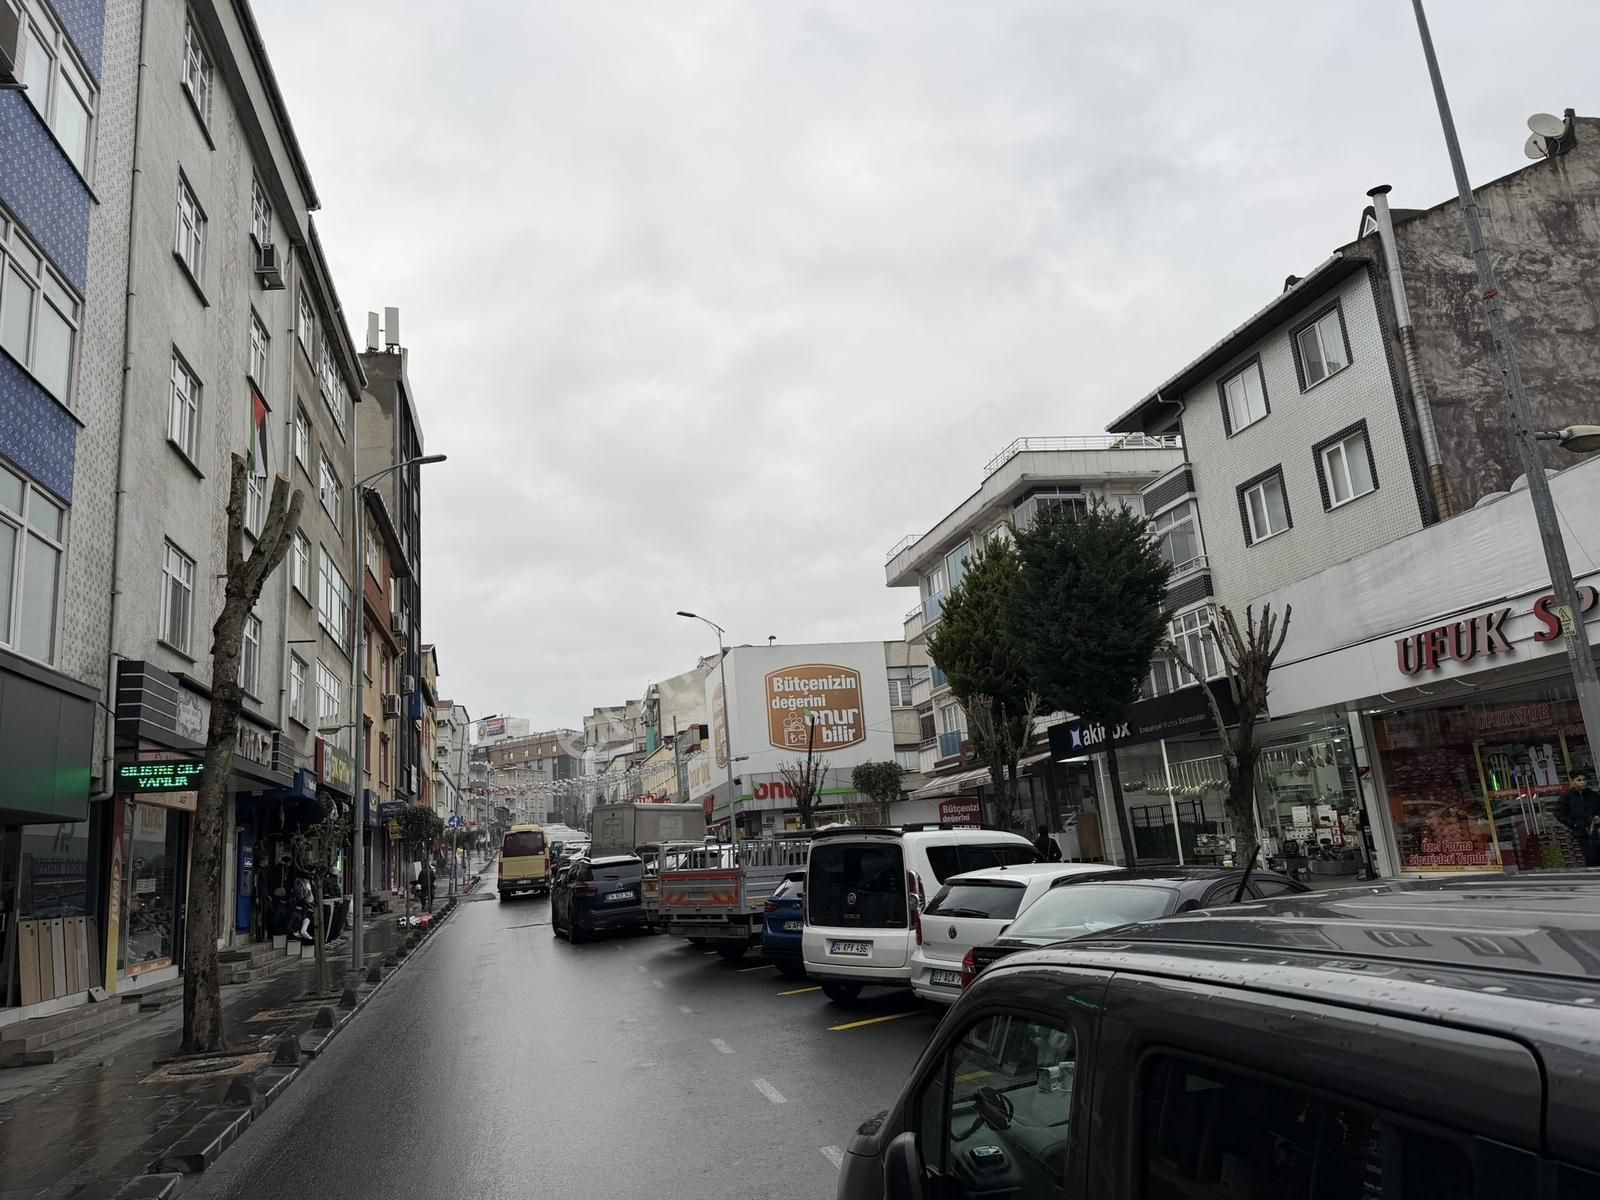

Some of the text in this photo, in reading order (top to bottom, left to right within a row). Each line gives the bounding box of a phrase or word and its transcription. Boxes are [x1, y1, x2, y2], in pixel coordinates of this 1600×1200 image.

[1394, 608, 1513, 676] UFUK
[773, 675, 857, 694] Bütçenizin
[772, 695, 826, 710] değerini
[805, 709, 859, 726] onur
[822, 726, 856, 743] bilir
[753, 780, 806, 800] onu
[943, 803, 980, 815] Bütçenizi
[1442, 840, 1474, 852] Forma
